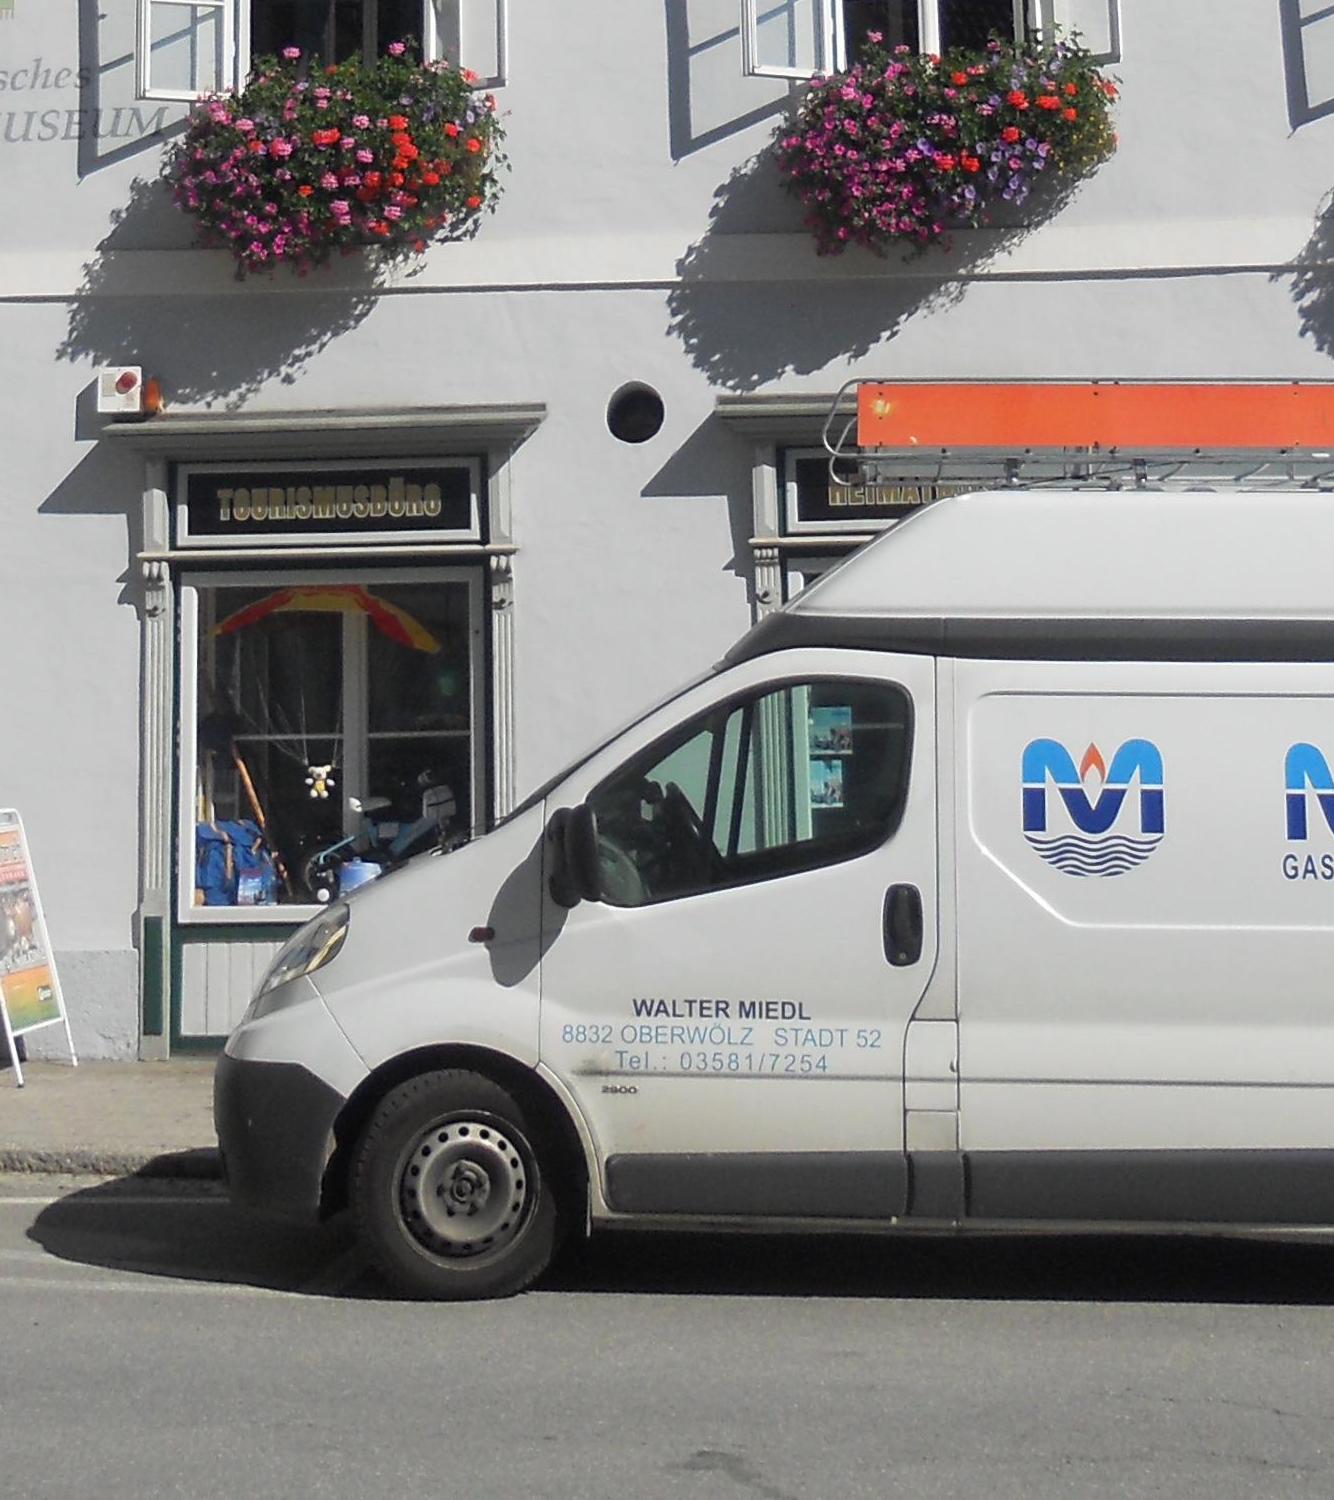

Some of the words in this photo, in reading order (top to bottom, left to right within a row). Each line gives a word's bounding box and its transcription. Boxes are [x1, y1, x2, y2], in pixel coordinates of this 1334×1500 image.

[217, 476, 442, 522] TOURISMUSBÜRO
[632, 998, 729, 1019] WALTER
[738, 1001, 811, 1021] MIEDL
[562, 1025, 613, 1044] 8832
[620, 1022, 754, 1047] OBERWÖLZ
[774, 1027, 848, 1048] STADT
[856, 1028, 882, 1048] 52
[679, 1052, 828, 1074] 03581/7254
